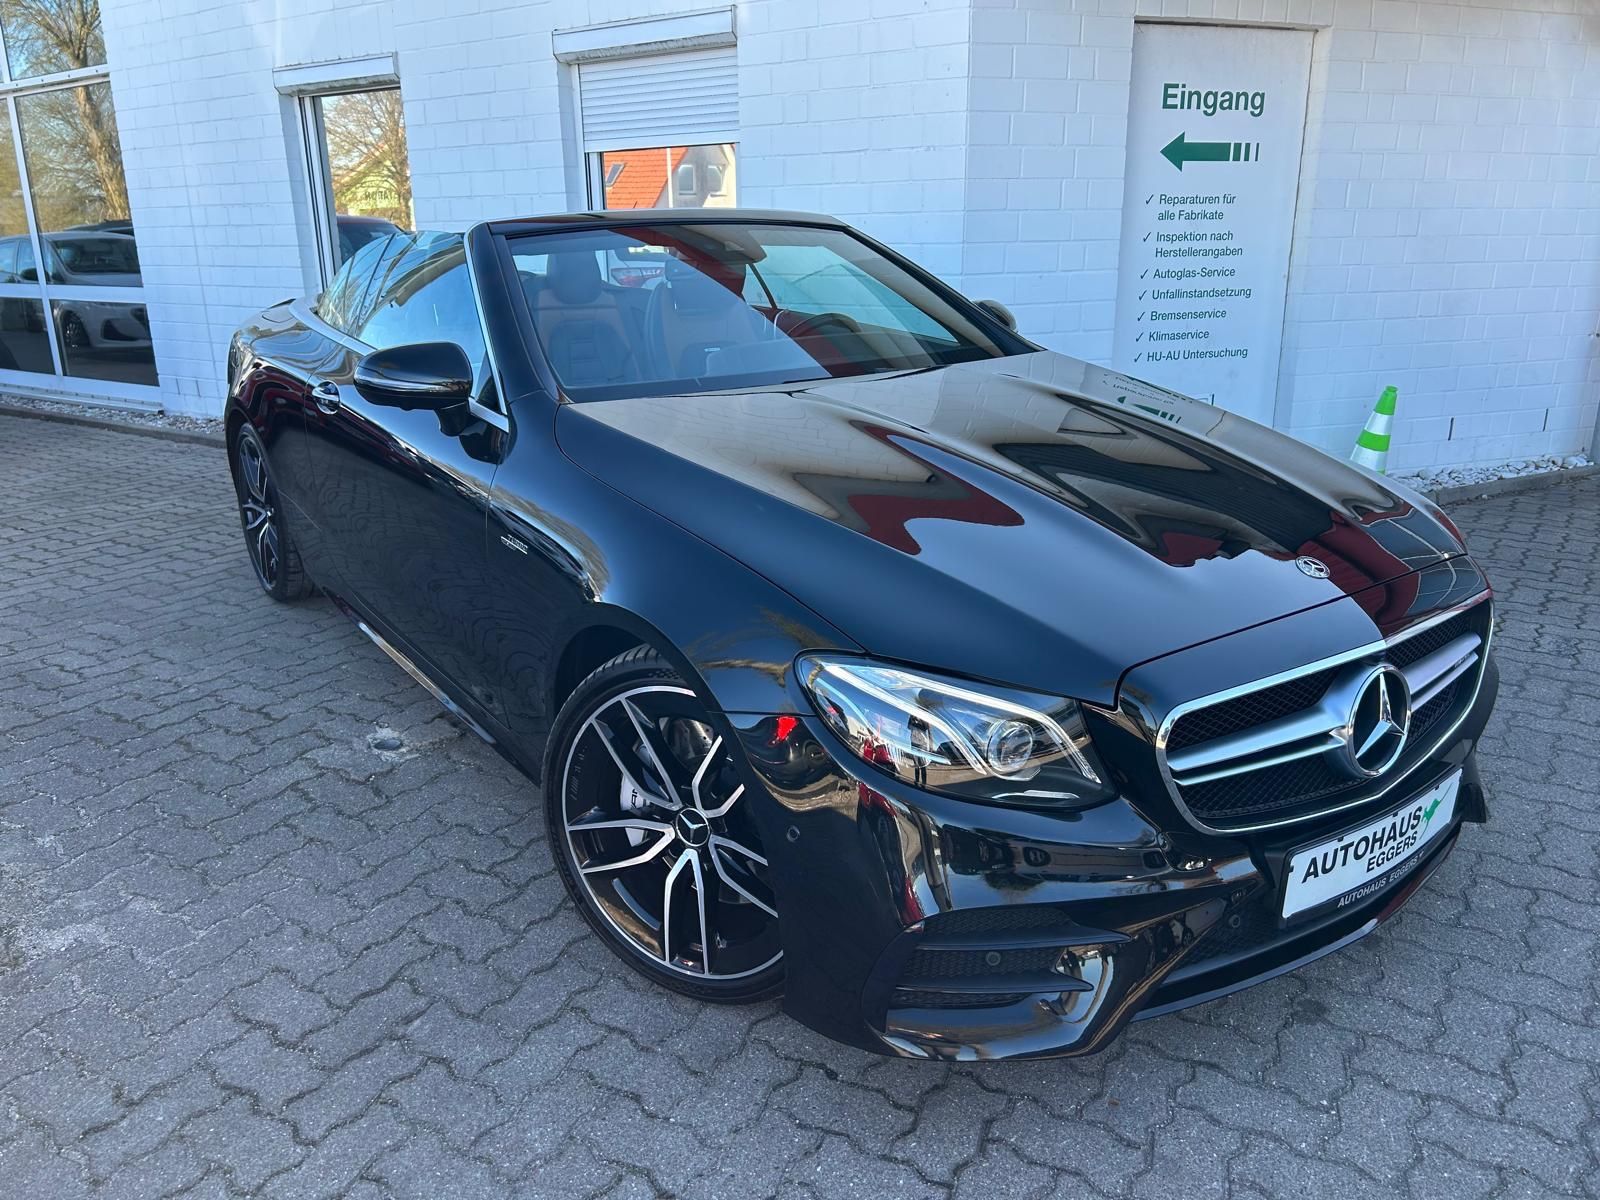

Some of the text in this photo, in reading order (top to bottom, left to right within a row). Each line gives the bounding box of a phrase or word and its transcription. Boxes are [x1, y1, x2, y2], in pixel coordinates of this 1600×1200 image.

[1161, 83, 1266, 117] Eingang
[1159, 194, 1236, 208] Reparaturen für
[1158, 209, 1224, 221] alle Fabrikate
[1156, 230, 1233, 245] Inspektion nach
[1155, 246, 1243, 261] Herstellerangaben
[1153, 267, 1236, 281] Autoglas-Service
[1151, 286, 1252, 300] Unfallinstandsetzung
[1150, 308, 1227, 321] Bremsenservice
[1148, 329, 1210, 342] Klimaservice
[1147, 347, 1248, 362] HU-AU Untersuchung
[1301, 805, 1423, 884] AUTOHAUS
[1366, 830, 1418, 874] EGGERS
[1337, 857, 1418, 908] AUTOHAUS EGGERS
